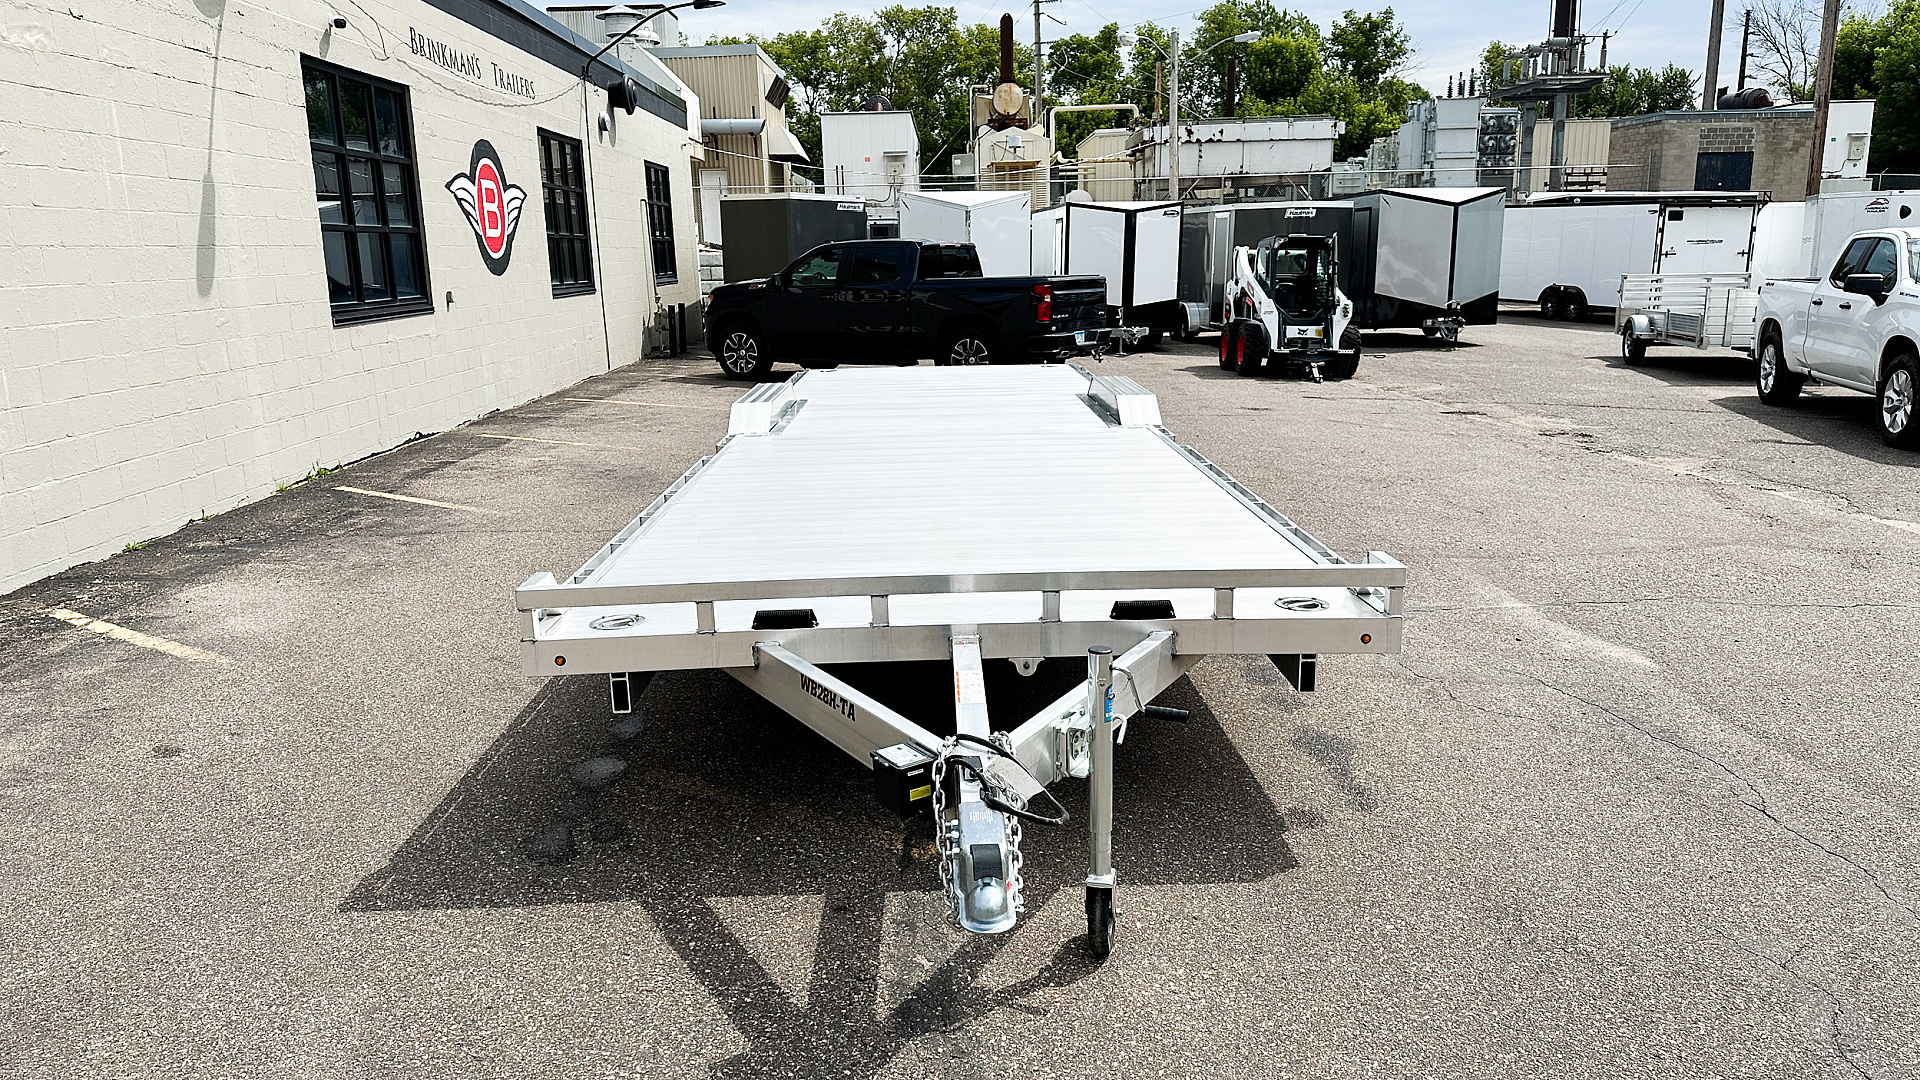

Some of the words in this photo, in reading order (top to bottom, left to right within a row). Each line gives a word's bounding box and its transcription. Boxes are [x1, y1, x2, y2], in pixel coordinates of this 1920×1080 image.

[409, 26, 482, 80] BRINKMAN'S
[491, 62, 536, 100] TRAILERS
[480, 178, 502, 238] B
[800, 672, 856, 722] WB28H-TA
